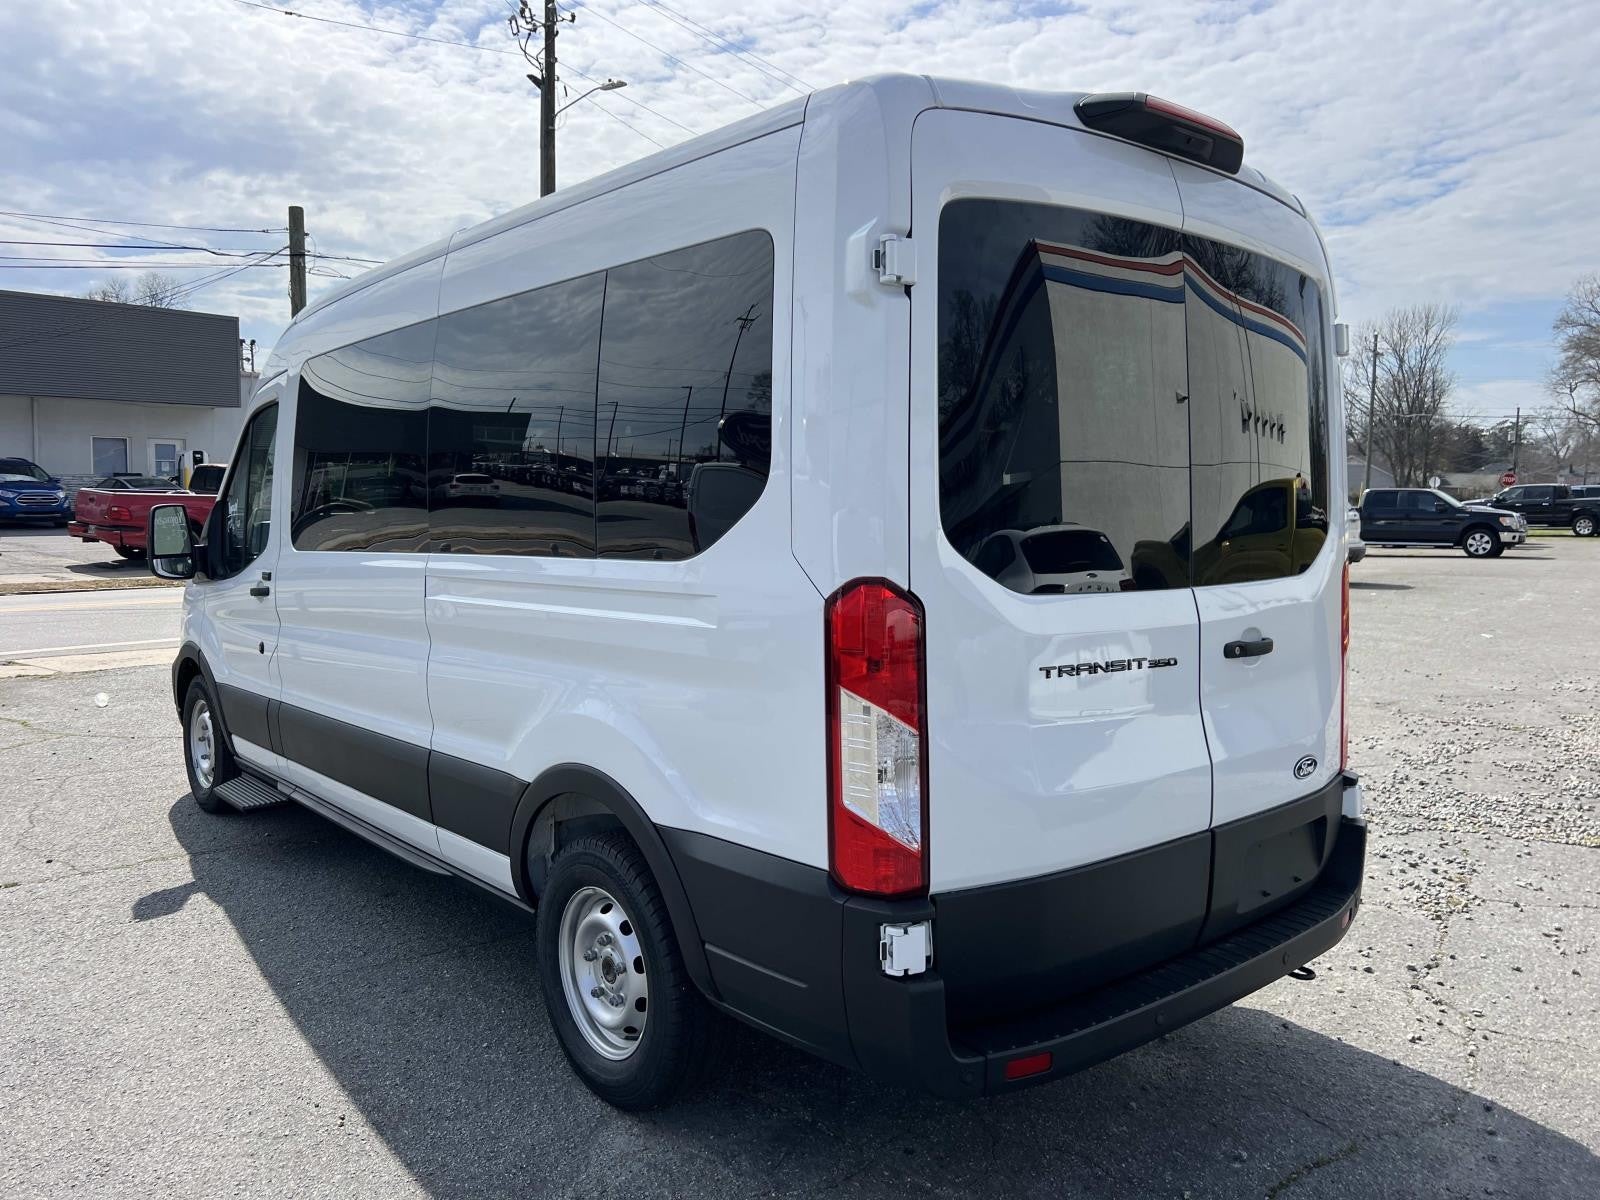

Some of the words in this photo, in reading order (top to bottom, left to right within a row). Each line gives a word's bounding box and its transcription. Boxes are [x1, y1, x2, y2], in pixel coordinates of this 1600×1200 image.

[1039, 657, 1147, 679] TRANSIT
[1147, 657, 1178, 669] 350
[1297, 758, 1316, 777] Ford
